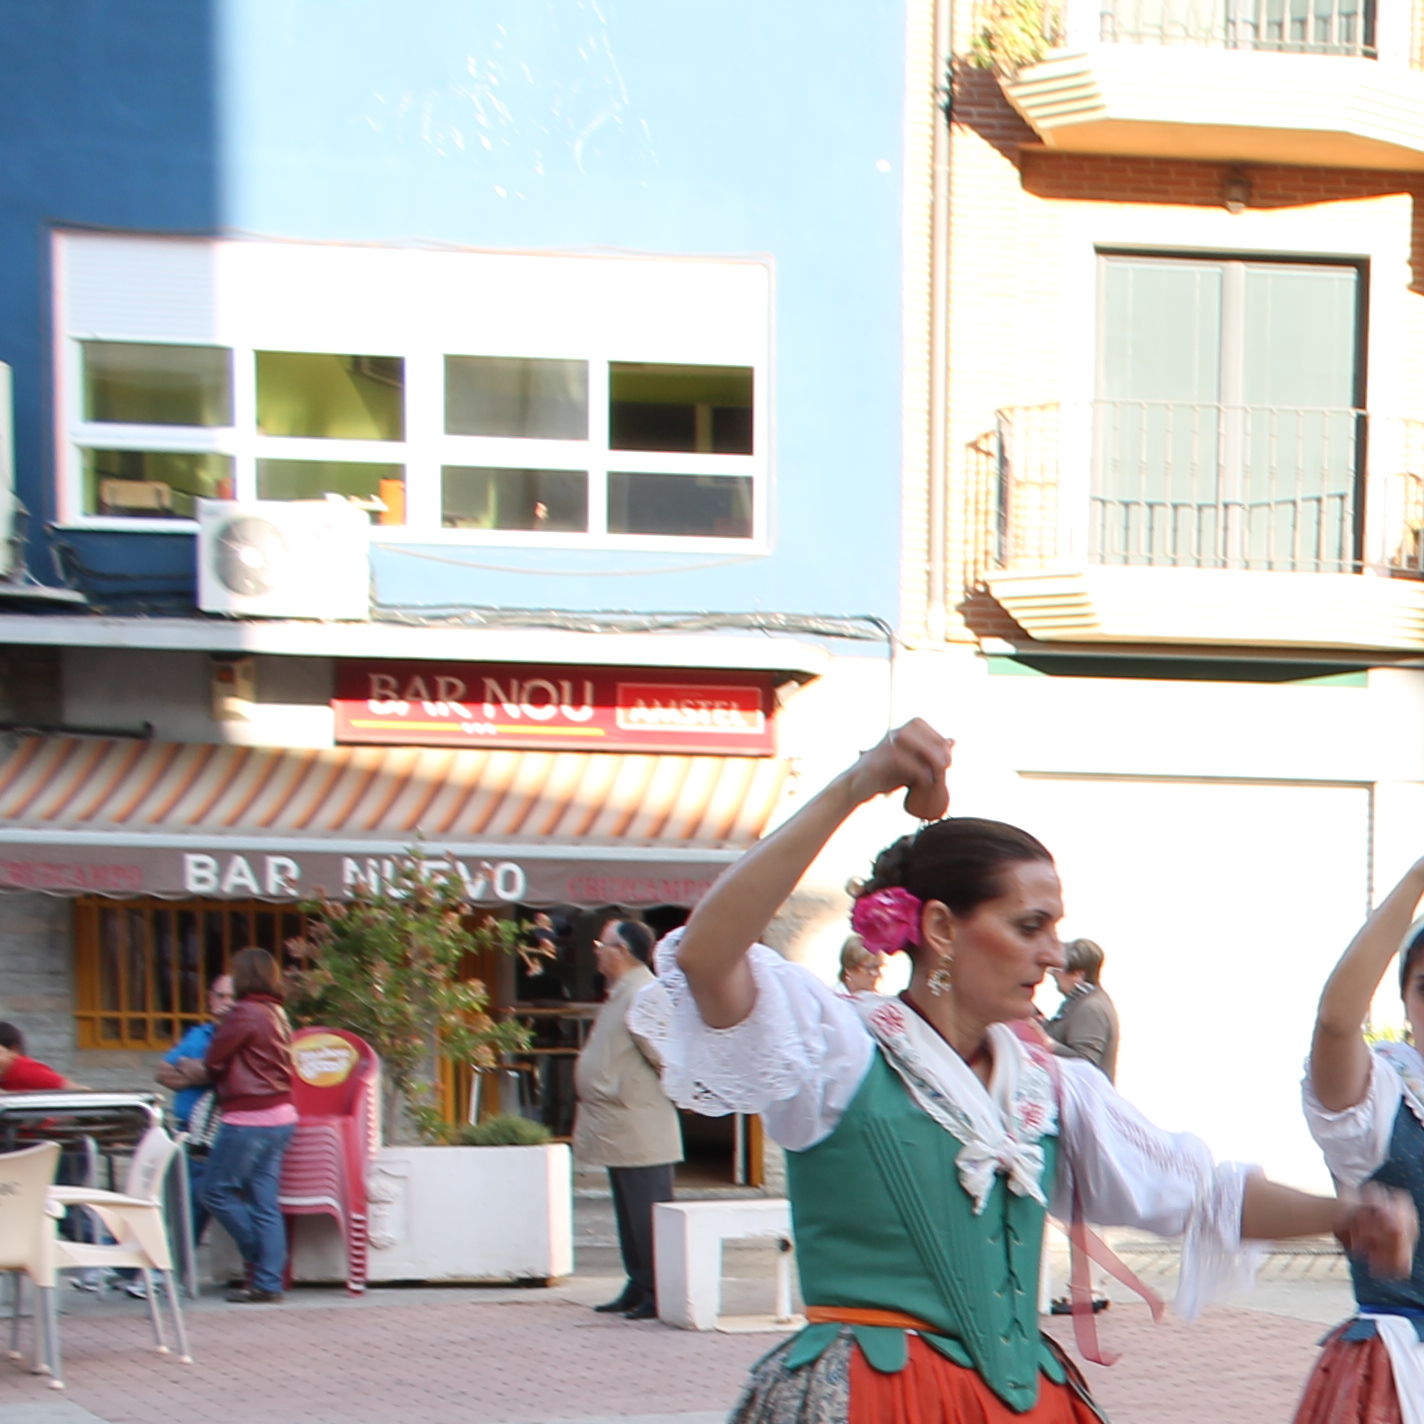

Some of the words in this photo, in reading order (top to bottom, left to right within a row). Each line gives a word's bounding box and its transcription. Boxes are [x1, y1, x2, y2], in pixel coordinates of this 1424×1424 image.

[368, 673, 473, 719] BAR
[482, 677, 593, 722] NOU
[629, 698, 748, 727] AMSTEL
[183, 853, 302, 896] BAR
